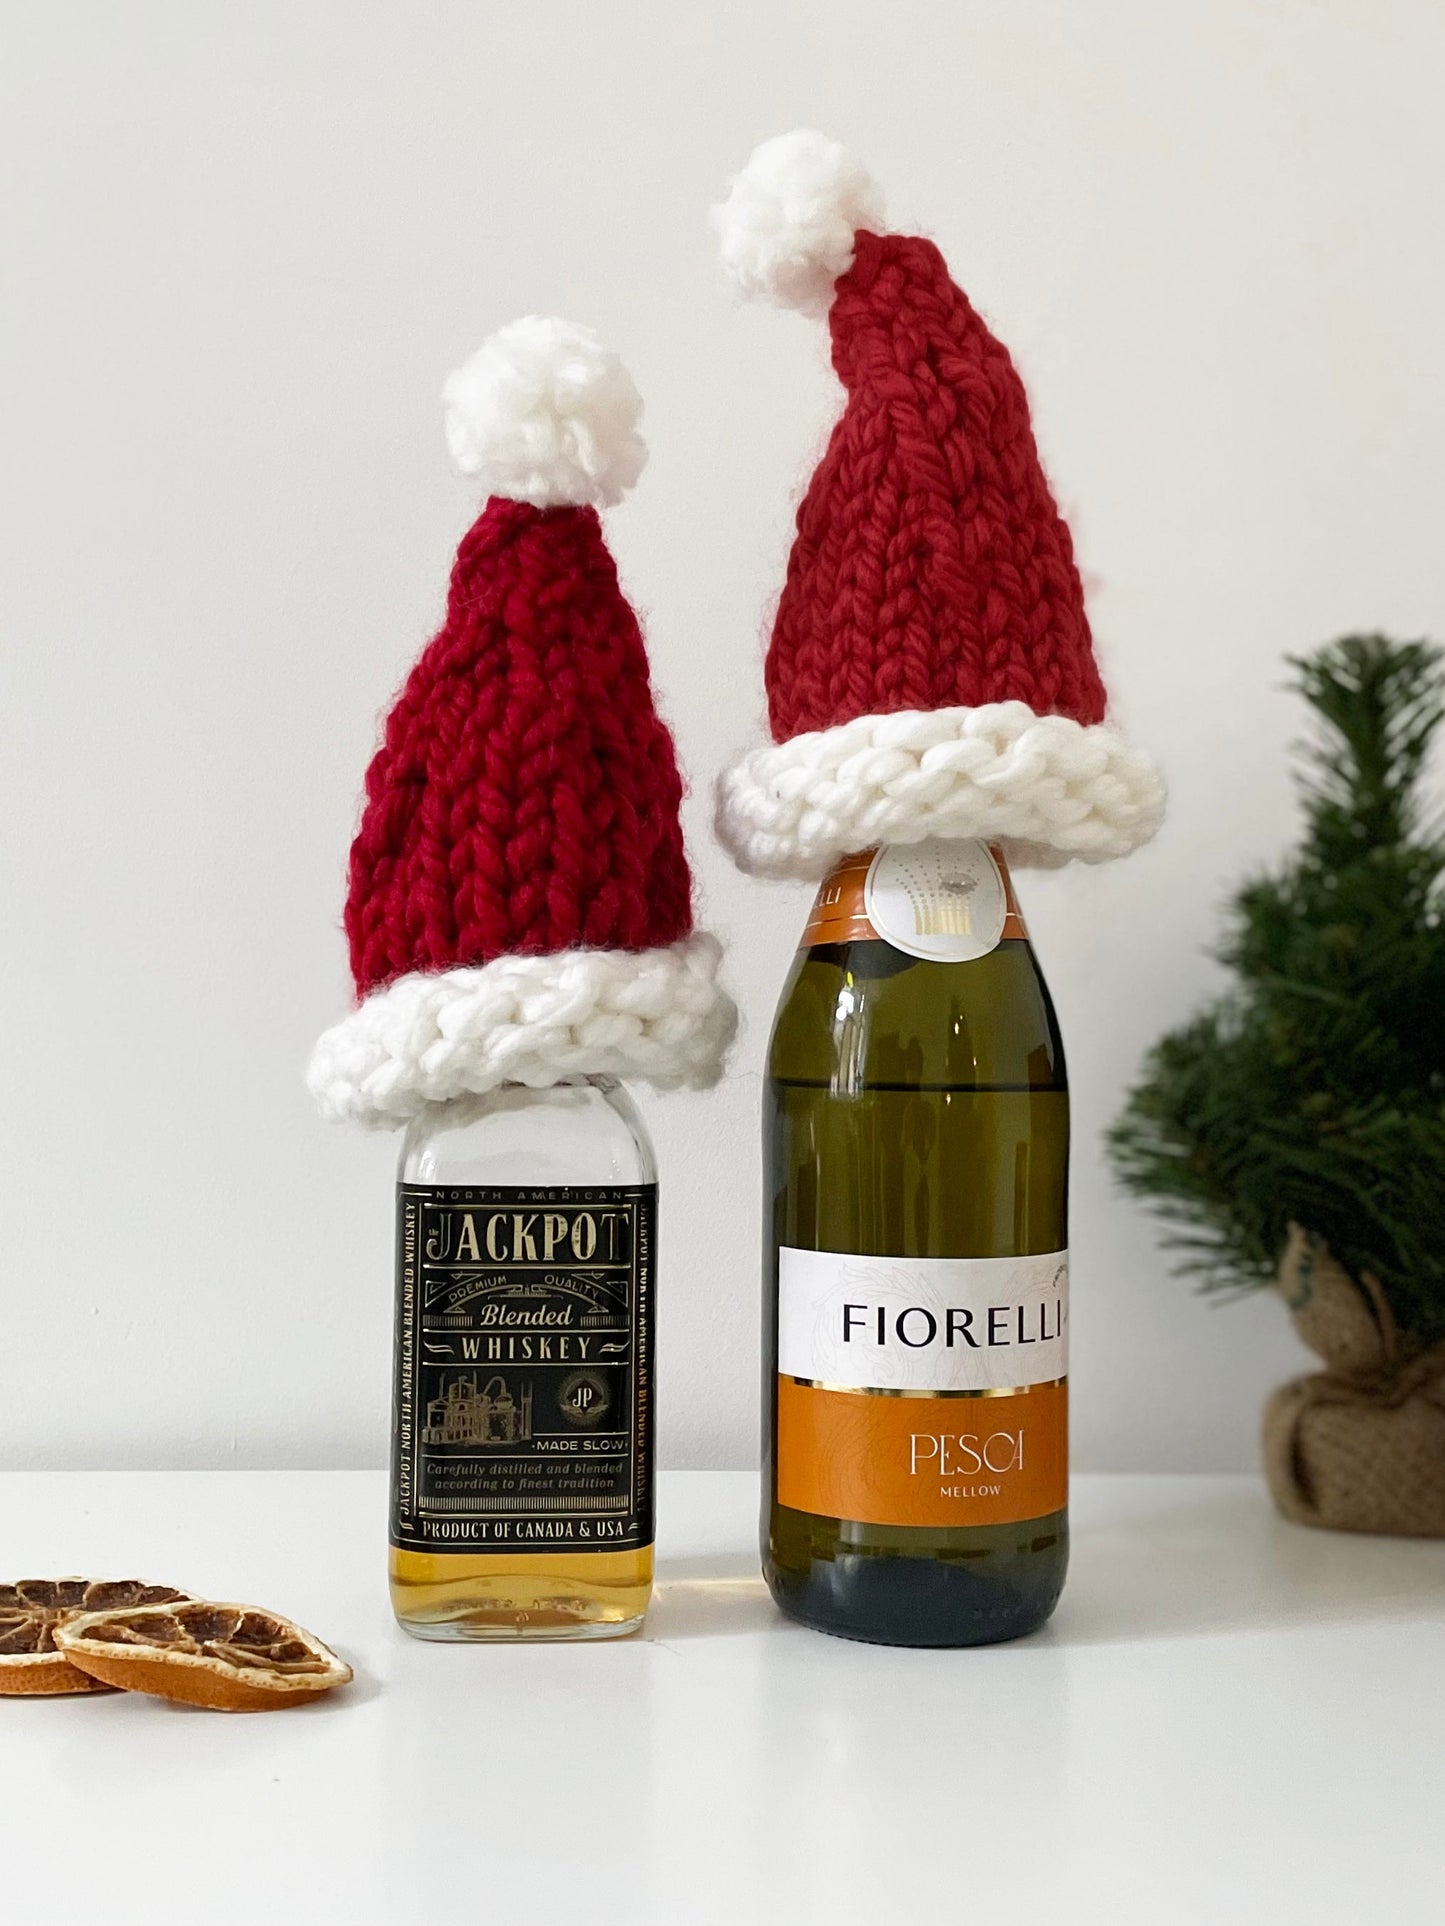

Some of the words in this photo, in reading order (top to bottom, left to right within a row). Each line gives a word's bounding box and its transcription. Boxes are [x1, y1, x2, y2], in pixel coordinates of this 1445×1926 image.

[436, 1191, 502, 1200] NORTH
[517, 1191, 622, 1200] AMERICAN
[404, 1202, 416, 1263] WHISKEY
[425, 1212, 630, 1262] JACKPOT
[403, 1268, 414, 1326] BLENDED
[448, 1275, 508, 1303] PREMIUM
[544, 1274, 600, 1301] QUALITY
[480, 1303, 574, 1327] Blended
[842, 1299, 1062, 1348] FIORELLI
[461, 1336, 592, 1360] WHISKEY
[402, 1330, 413, 1399] AMERICAN
[571, 1387, 594, 1409] JP
[401, 1403, 412, 1450] NORTH
[536, 1441, 578, 1451] MADE
[427, 1463, 486, 1477] Carefully
[489, 1462, 542, 1475] distilled
[546, 1463, 569, 1475] and
[575, 1462, 623, 1474] blended
[400, 1452, 412, 1516] JACKPOT
[434, 1477, 498, 1492] according
[502, 1479, 515, 1490] to
[518, 1477, 553, 1491] finest
[558, 1477, 615, 1489] tradition
[940, 1485, 1002, 1498] MELLOW
[423, 1521, 490, 1539] PRODUCT
[494, 1522, 510, 1539] OF
[516, 1521, 574, 1538] CANADA
[579, 1521, 592, 1538] &
[597, 1520, 624, 1537] USA
